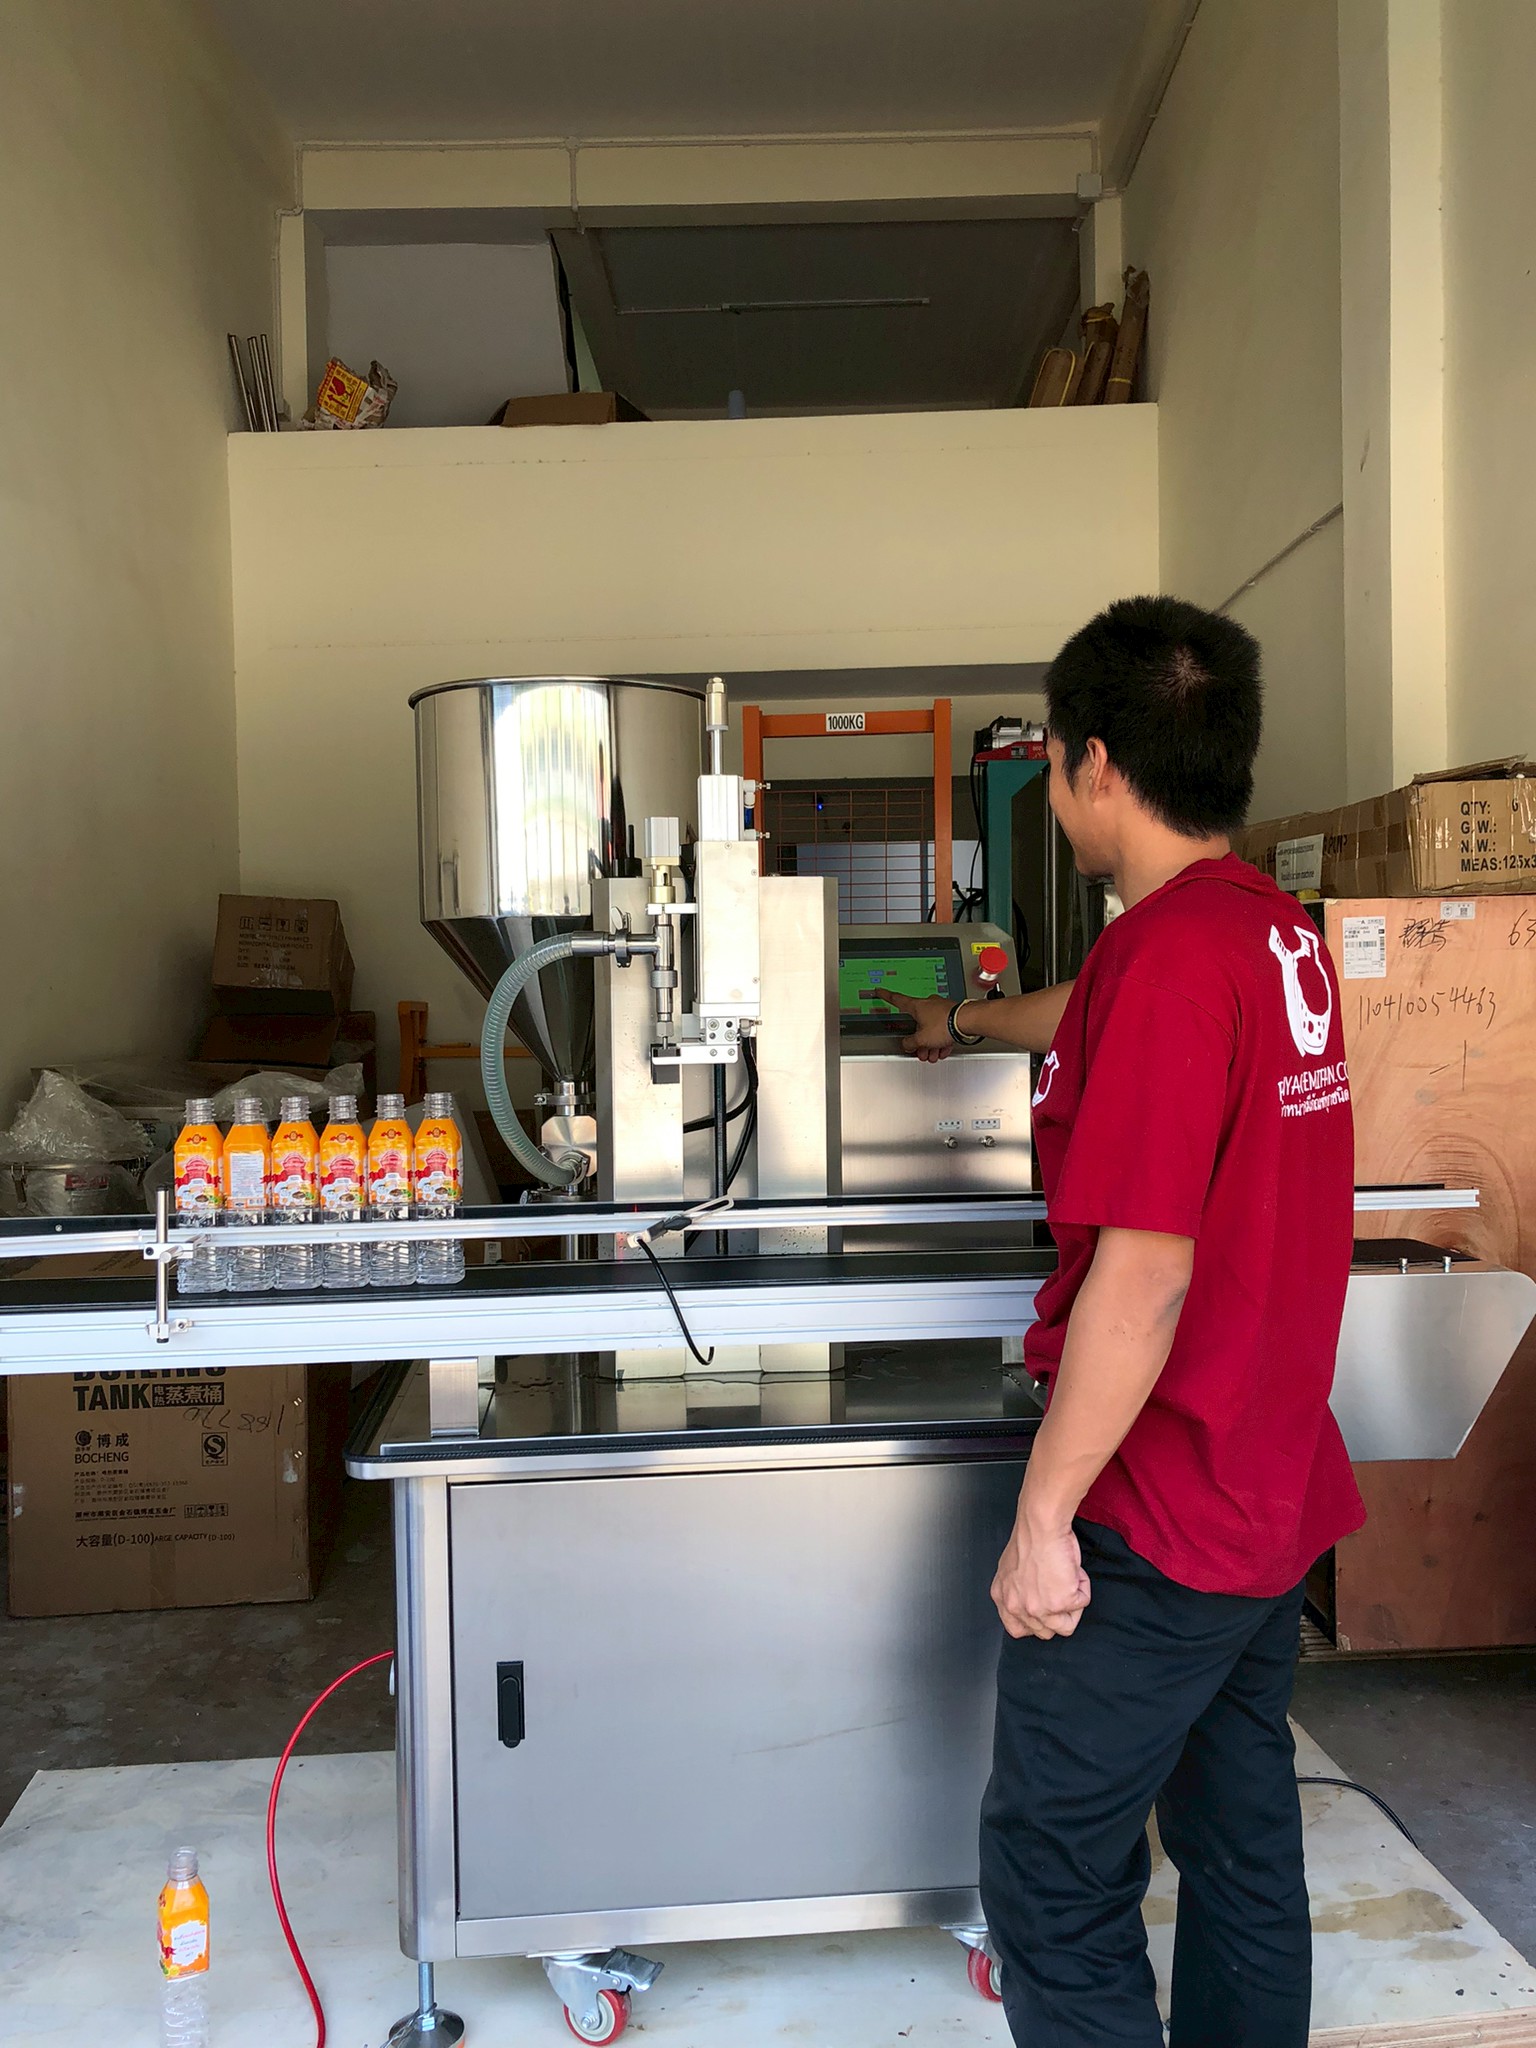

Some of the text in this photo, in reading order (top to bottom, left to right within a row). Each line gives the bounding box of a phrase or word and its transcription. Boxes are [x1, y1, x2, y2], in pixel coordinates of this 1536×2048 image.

[828, 714, 864, 730] 1000KG
[1460, 800, 1490, 816] QTY:
[73, 1383, 152, 1411] TANK
[74, 1451, 129, 1465] BOCHENG
